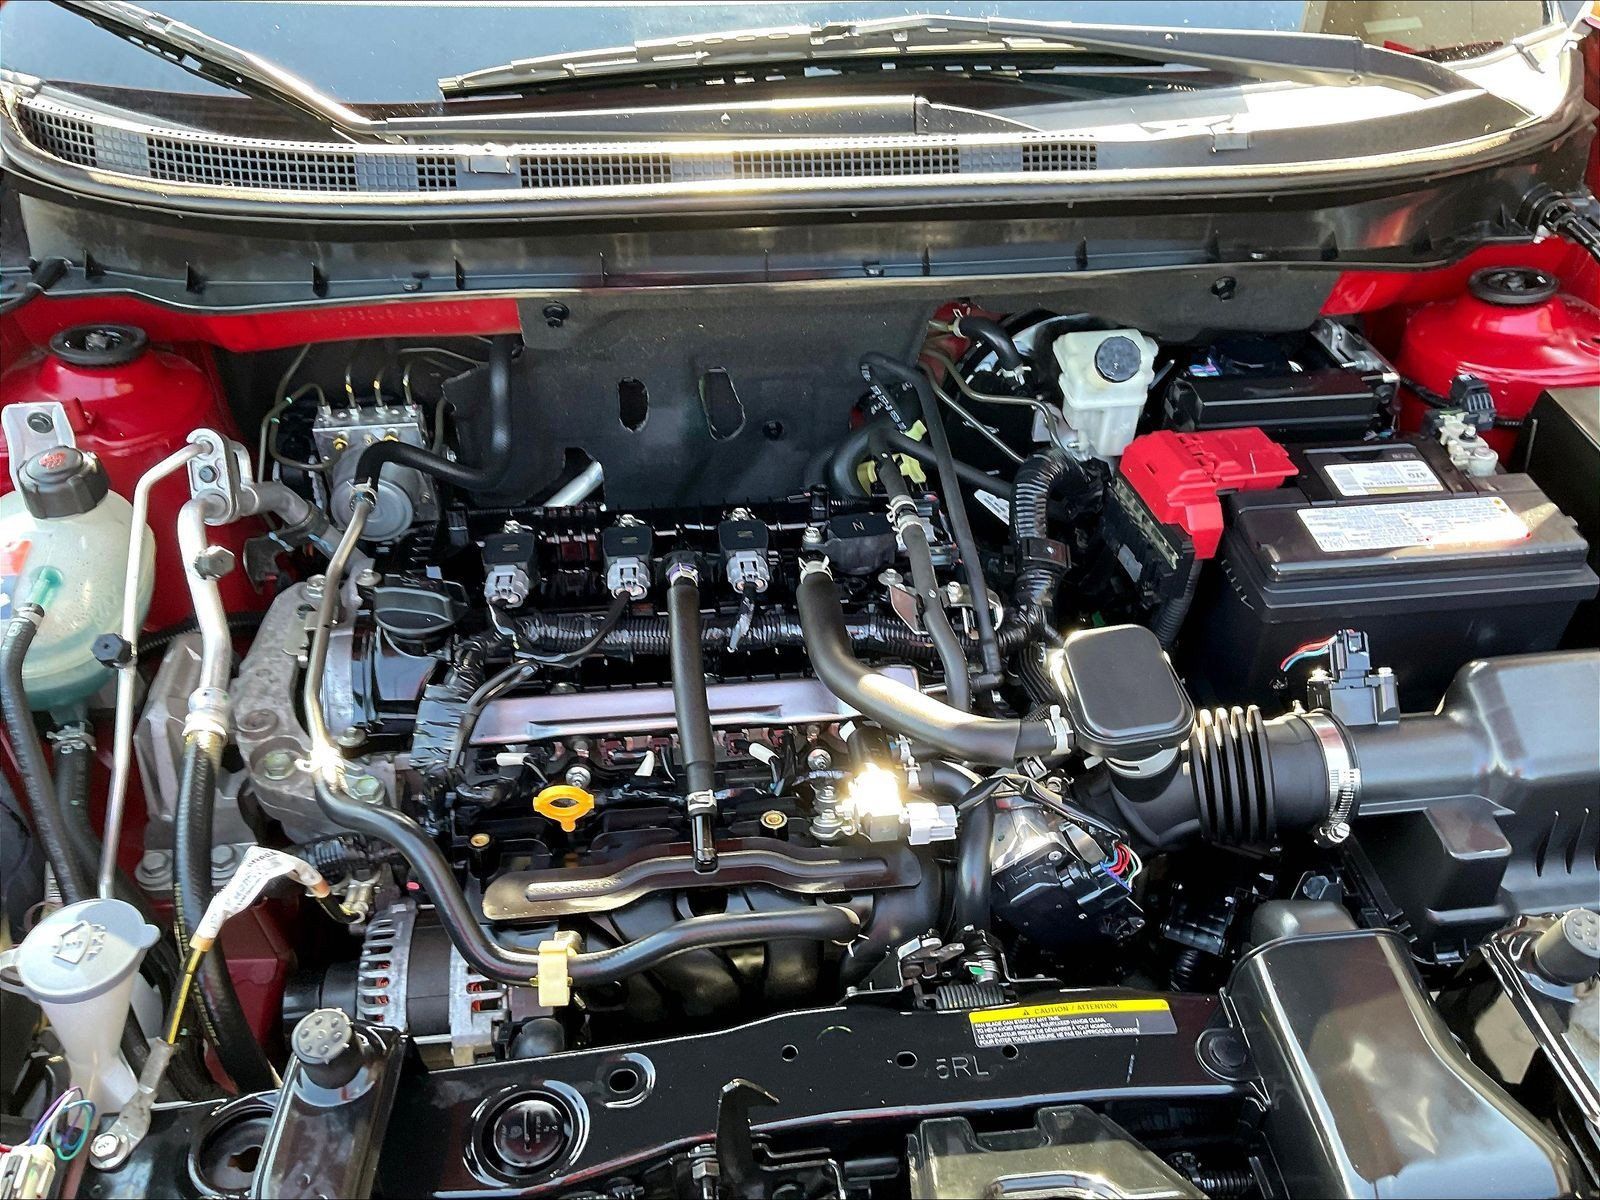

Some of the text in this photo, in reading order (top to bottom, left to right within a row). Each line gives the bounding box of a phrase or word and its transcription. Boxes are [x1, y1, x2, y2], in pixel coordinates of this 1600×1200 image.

[1035, 1005, 1069, 1015] CAUTION
[1077, 1003, 1118, 1011] ATTENTION
[936, 1055, 989, 1079] 5RL
